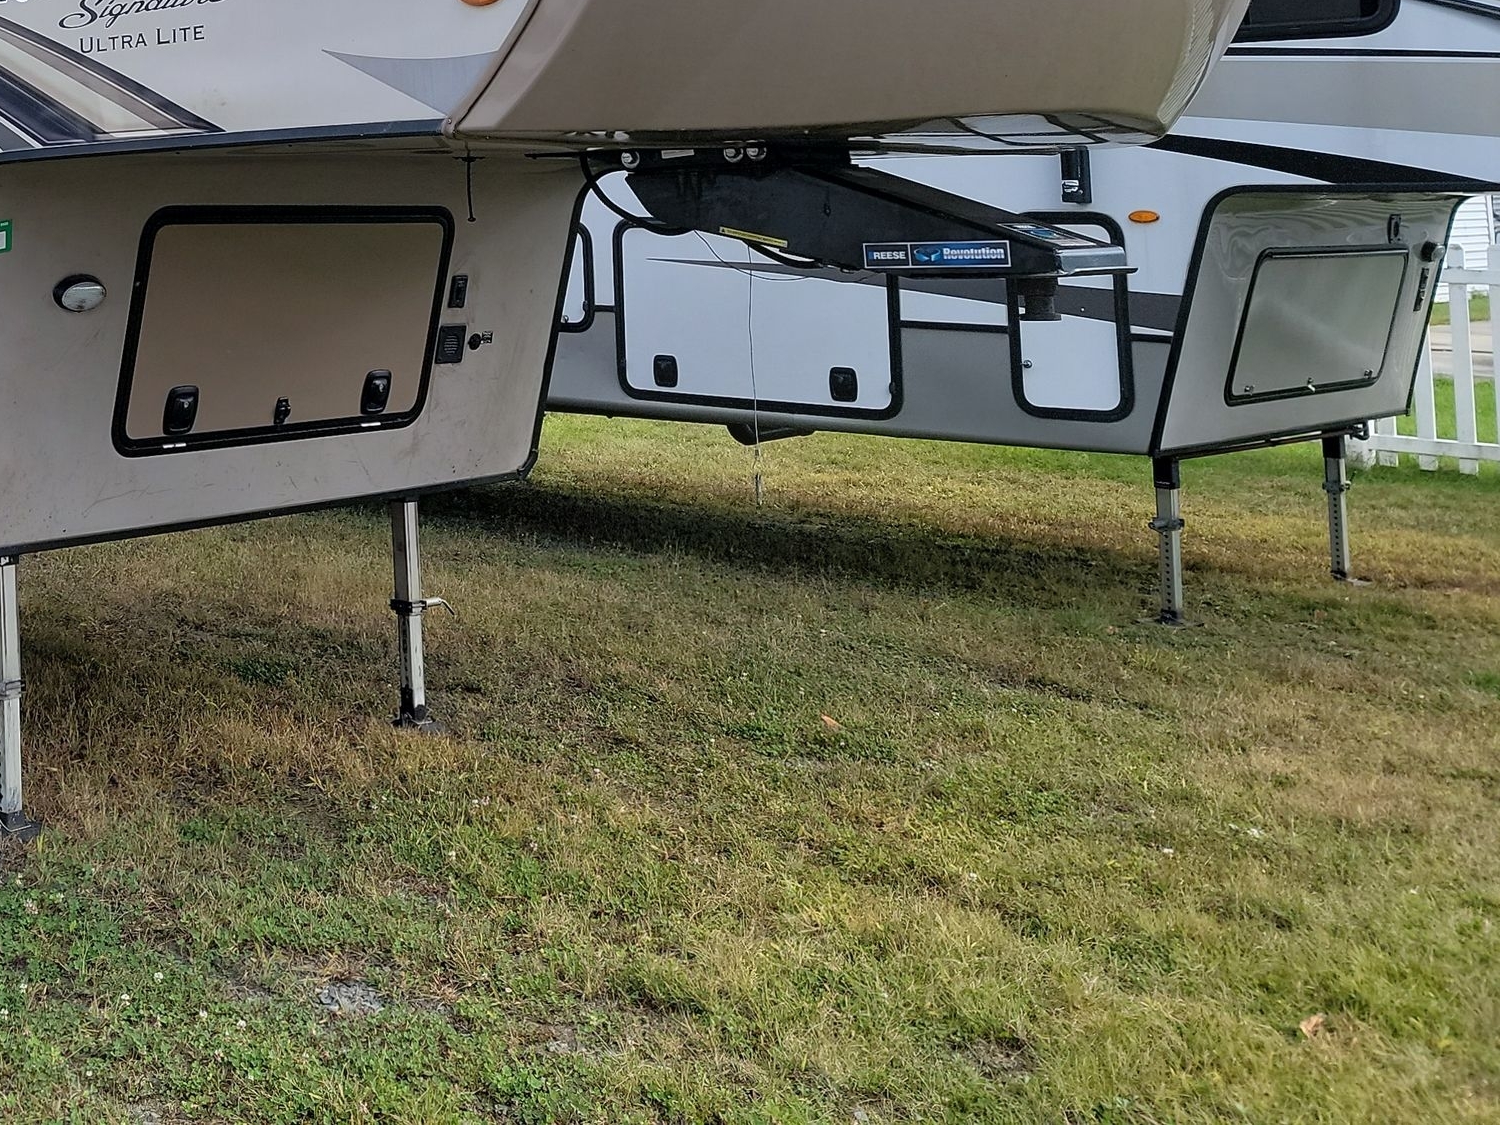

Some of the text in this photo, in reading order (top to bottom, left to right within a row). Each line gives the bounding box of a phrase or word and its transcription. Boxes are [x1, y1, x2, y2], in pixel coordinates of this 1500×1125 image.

[79, 25, 206, 54] ULTRA LITE
[872, 251, 907, 260] REESE
[942, 246, 1006, 260] Revolution
